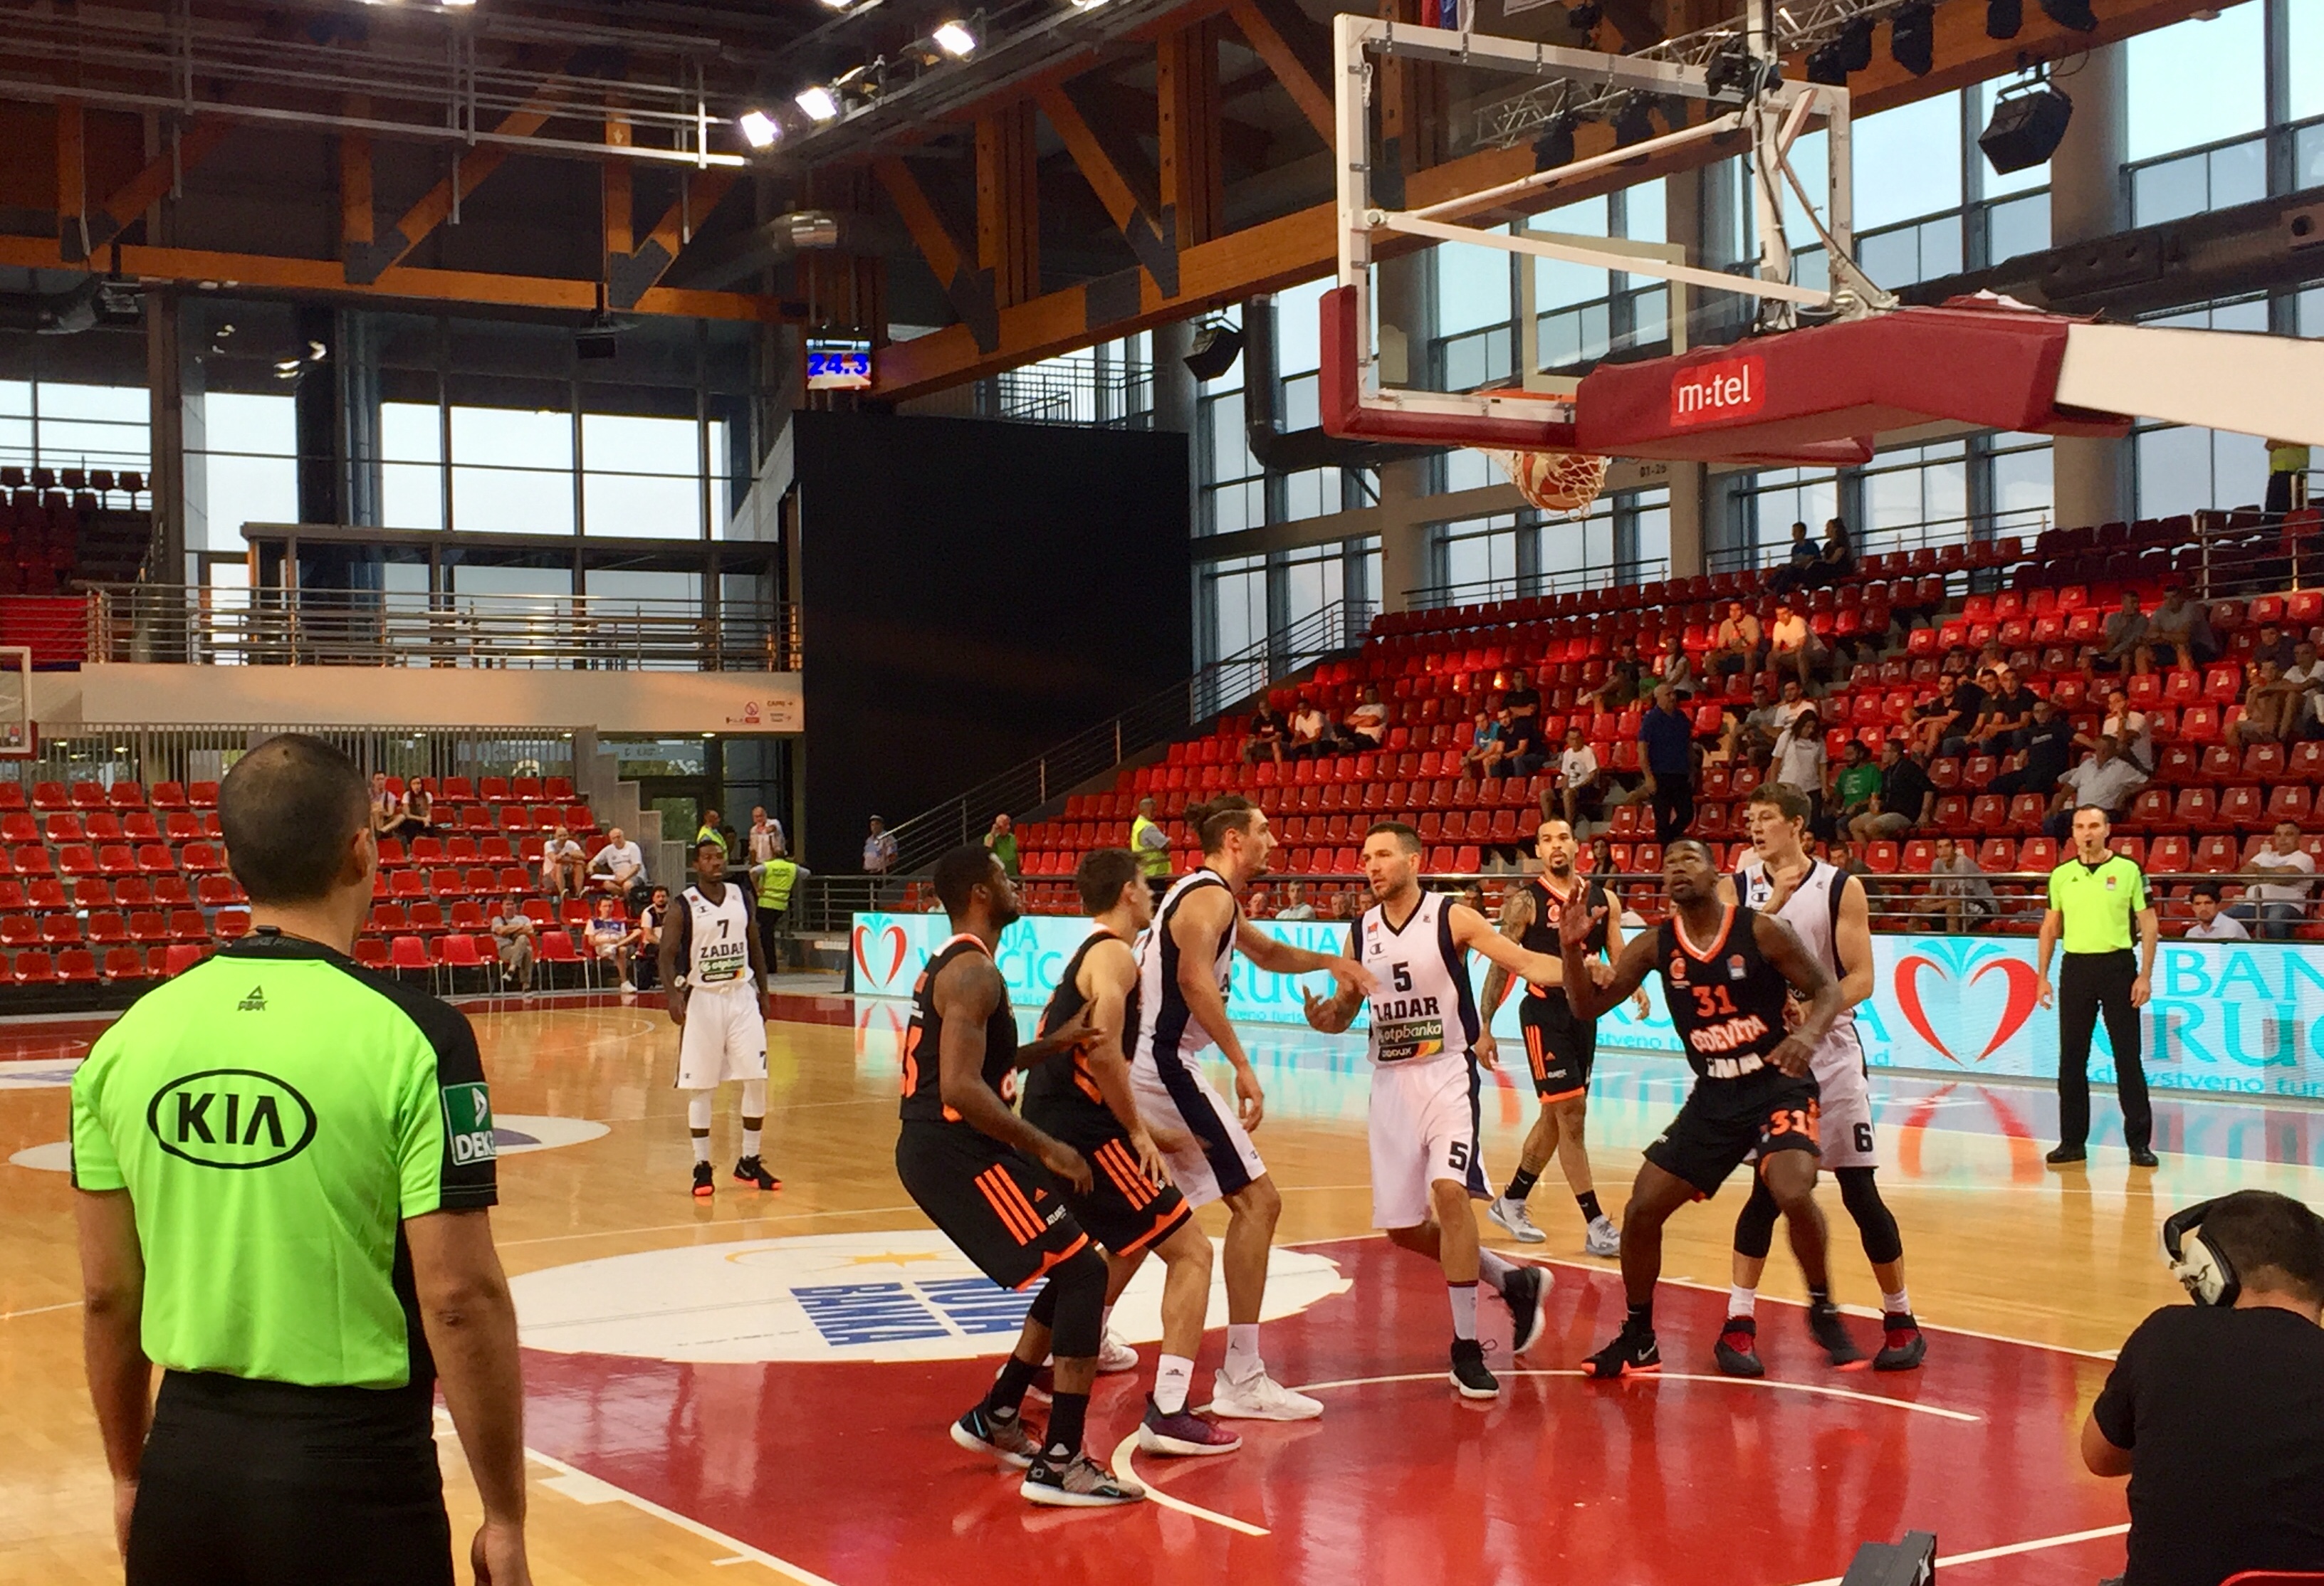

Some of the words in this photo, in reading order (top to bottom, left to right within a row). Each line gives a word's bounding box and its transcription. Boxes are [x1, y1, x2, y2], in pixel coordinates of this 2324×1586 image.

[808, 353, 869, 376] 24.3
[1677, 364, 1752, 413] m:tel
[717, 920, 729, 938] 7
[1392, 962, 1413, 992] 5
[2165, 950, 2324, 1001] BAN
[1692, 984, 1738, 1017] 31
[177, 1092, 286, 1148] KIA
[1770, 1109, 1809, 1136] 31
[1853, 1122, 1873, 1152] 6
[1448, 1140, 1468, 1172] 5
